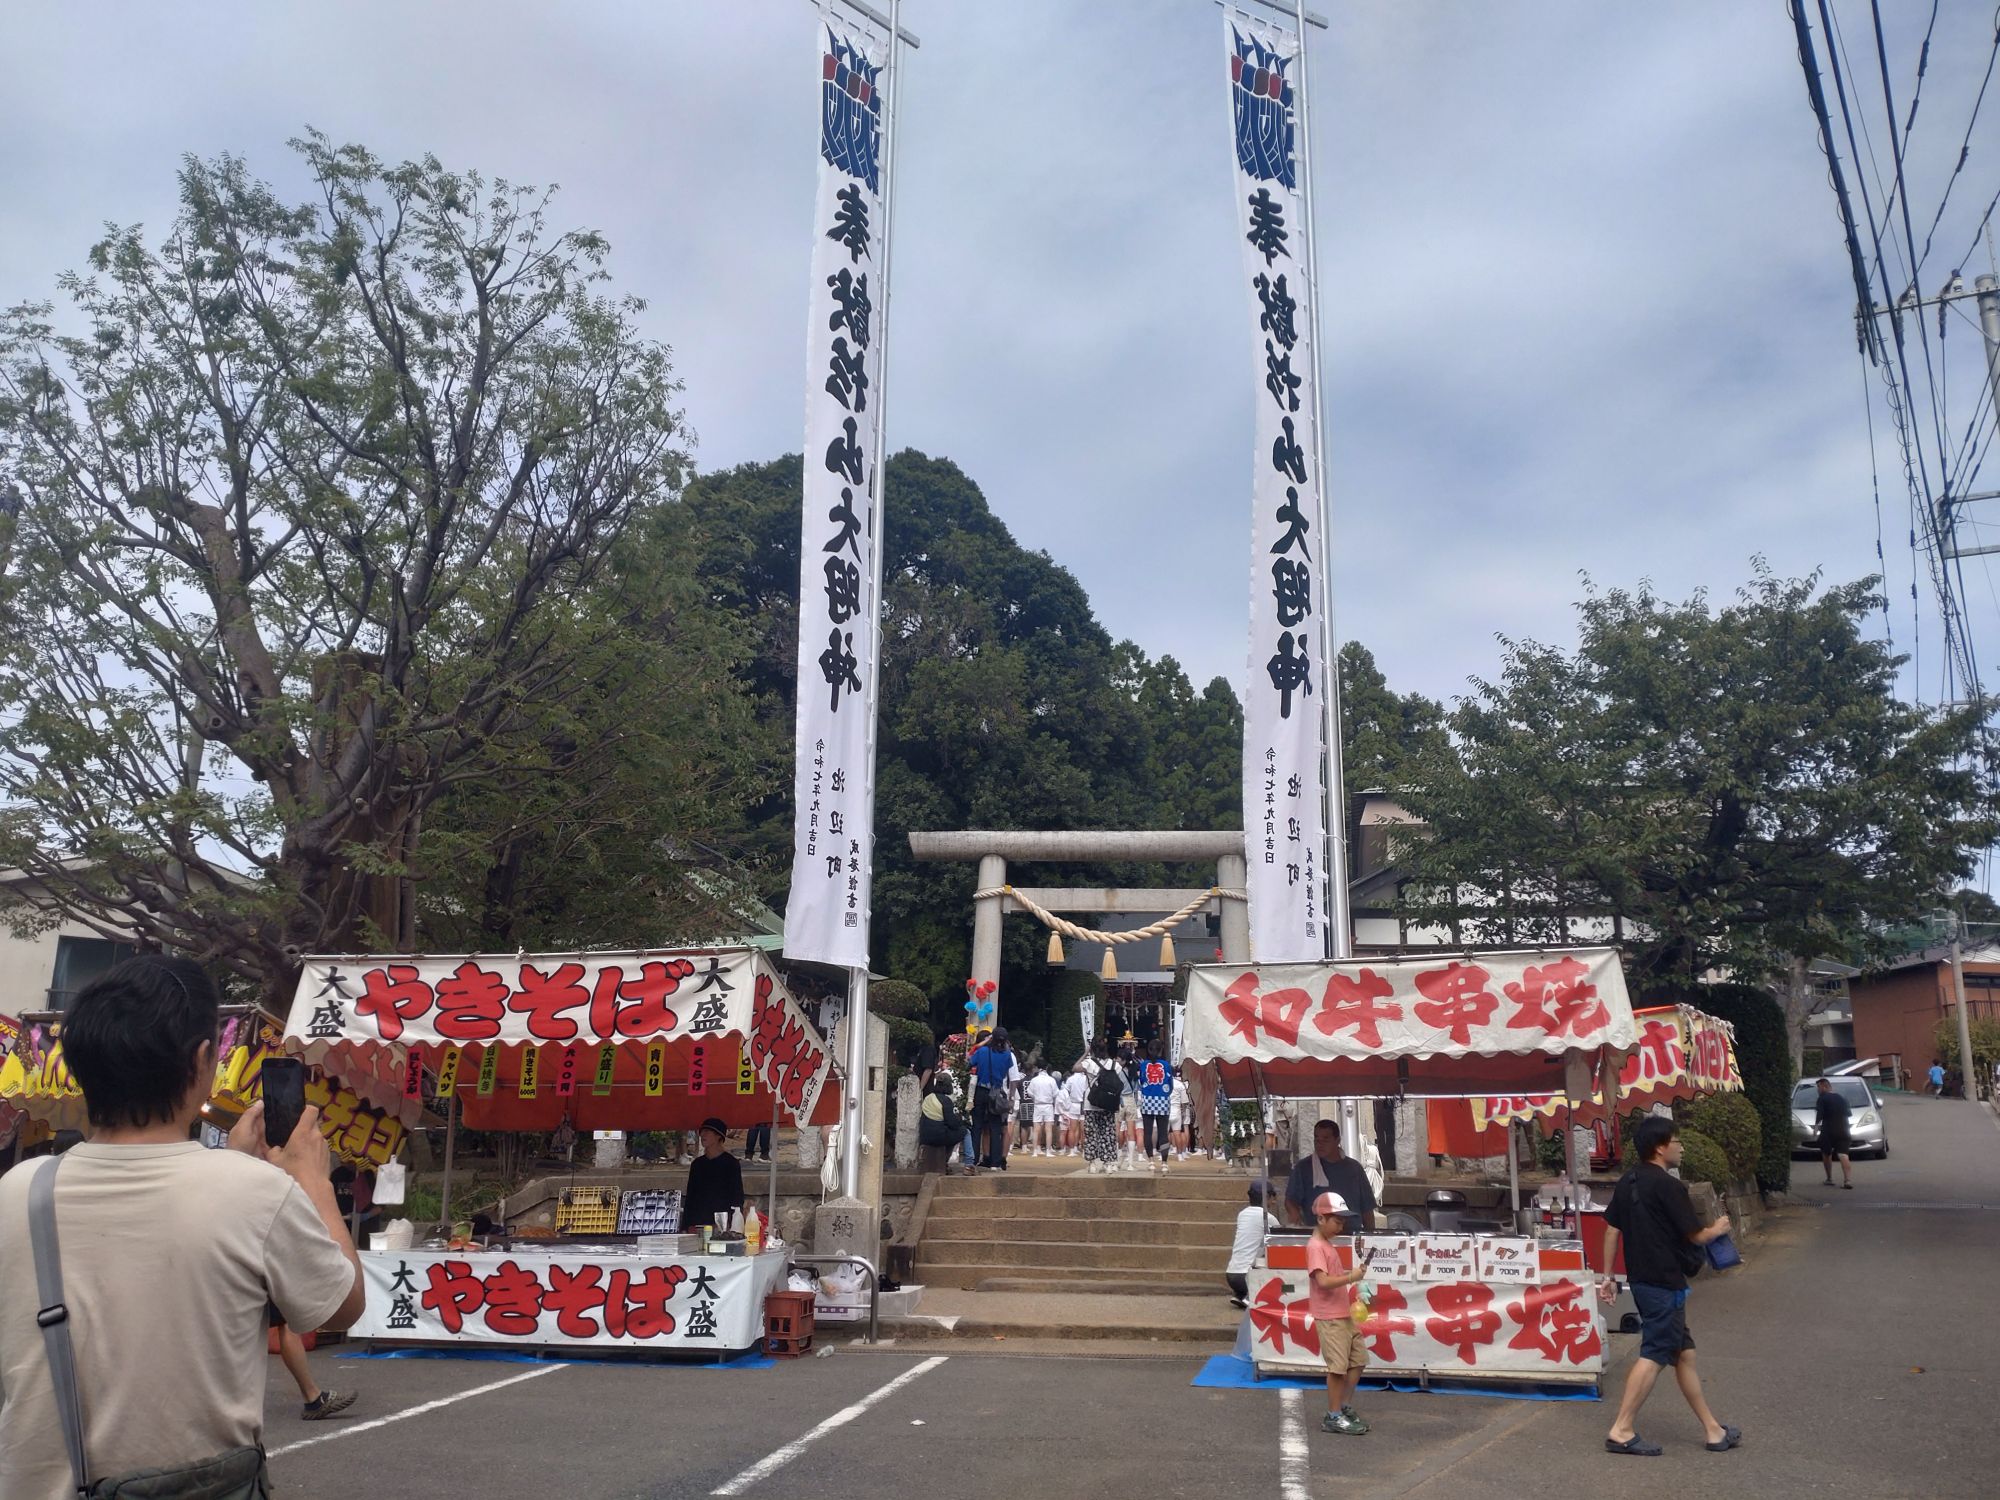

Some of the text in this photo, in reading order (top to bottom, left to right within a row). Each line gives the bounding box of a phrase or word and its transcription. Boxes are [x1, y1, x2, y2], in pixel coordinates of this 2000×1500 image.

[306, 966, 353, 1038] 大盛
[354, 958, 695, 1040] やきそば
[688, 957, 735, 1033] 大盛
[1217, 955, 1612, 1048] 和牛串焼
[441, 1052, 457, 1092] キャベツ
[481, 1046, 495, 1092] 目玉焼き
[523, 1048, 535, 1086] 焼きそば
[599, 1046, 613, 1083] 大盛り
[648, 1049, 661, 1091] 青のり
[1145, 1062, 1165, 1085] 祭
[1495, 1247, 1519, 1260] タン
[385, 1260, 419, 1329] 大盛
[421, 1259, 687, 1338] やきそば
[684, 1266, 720, 1338] 大盛
[1250, 1277, 1601, 1365] 和牛串焼
